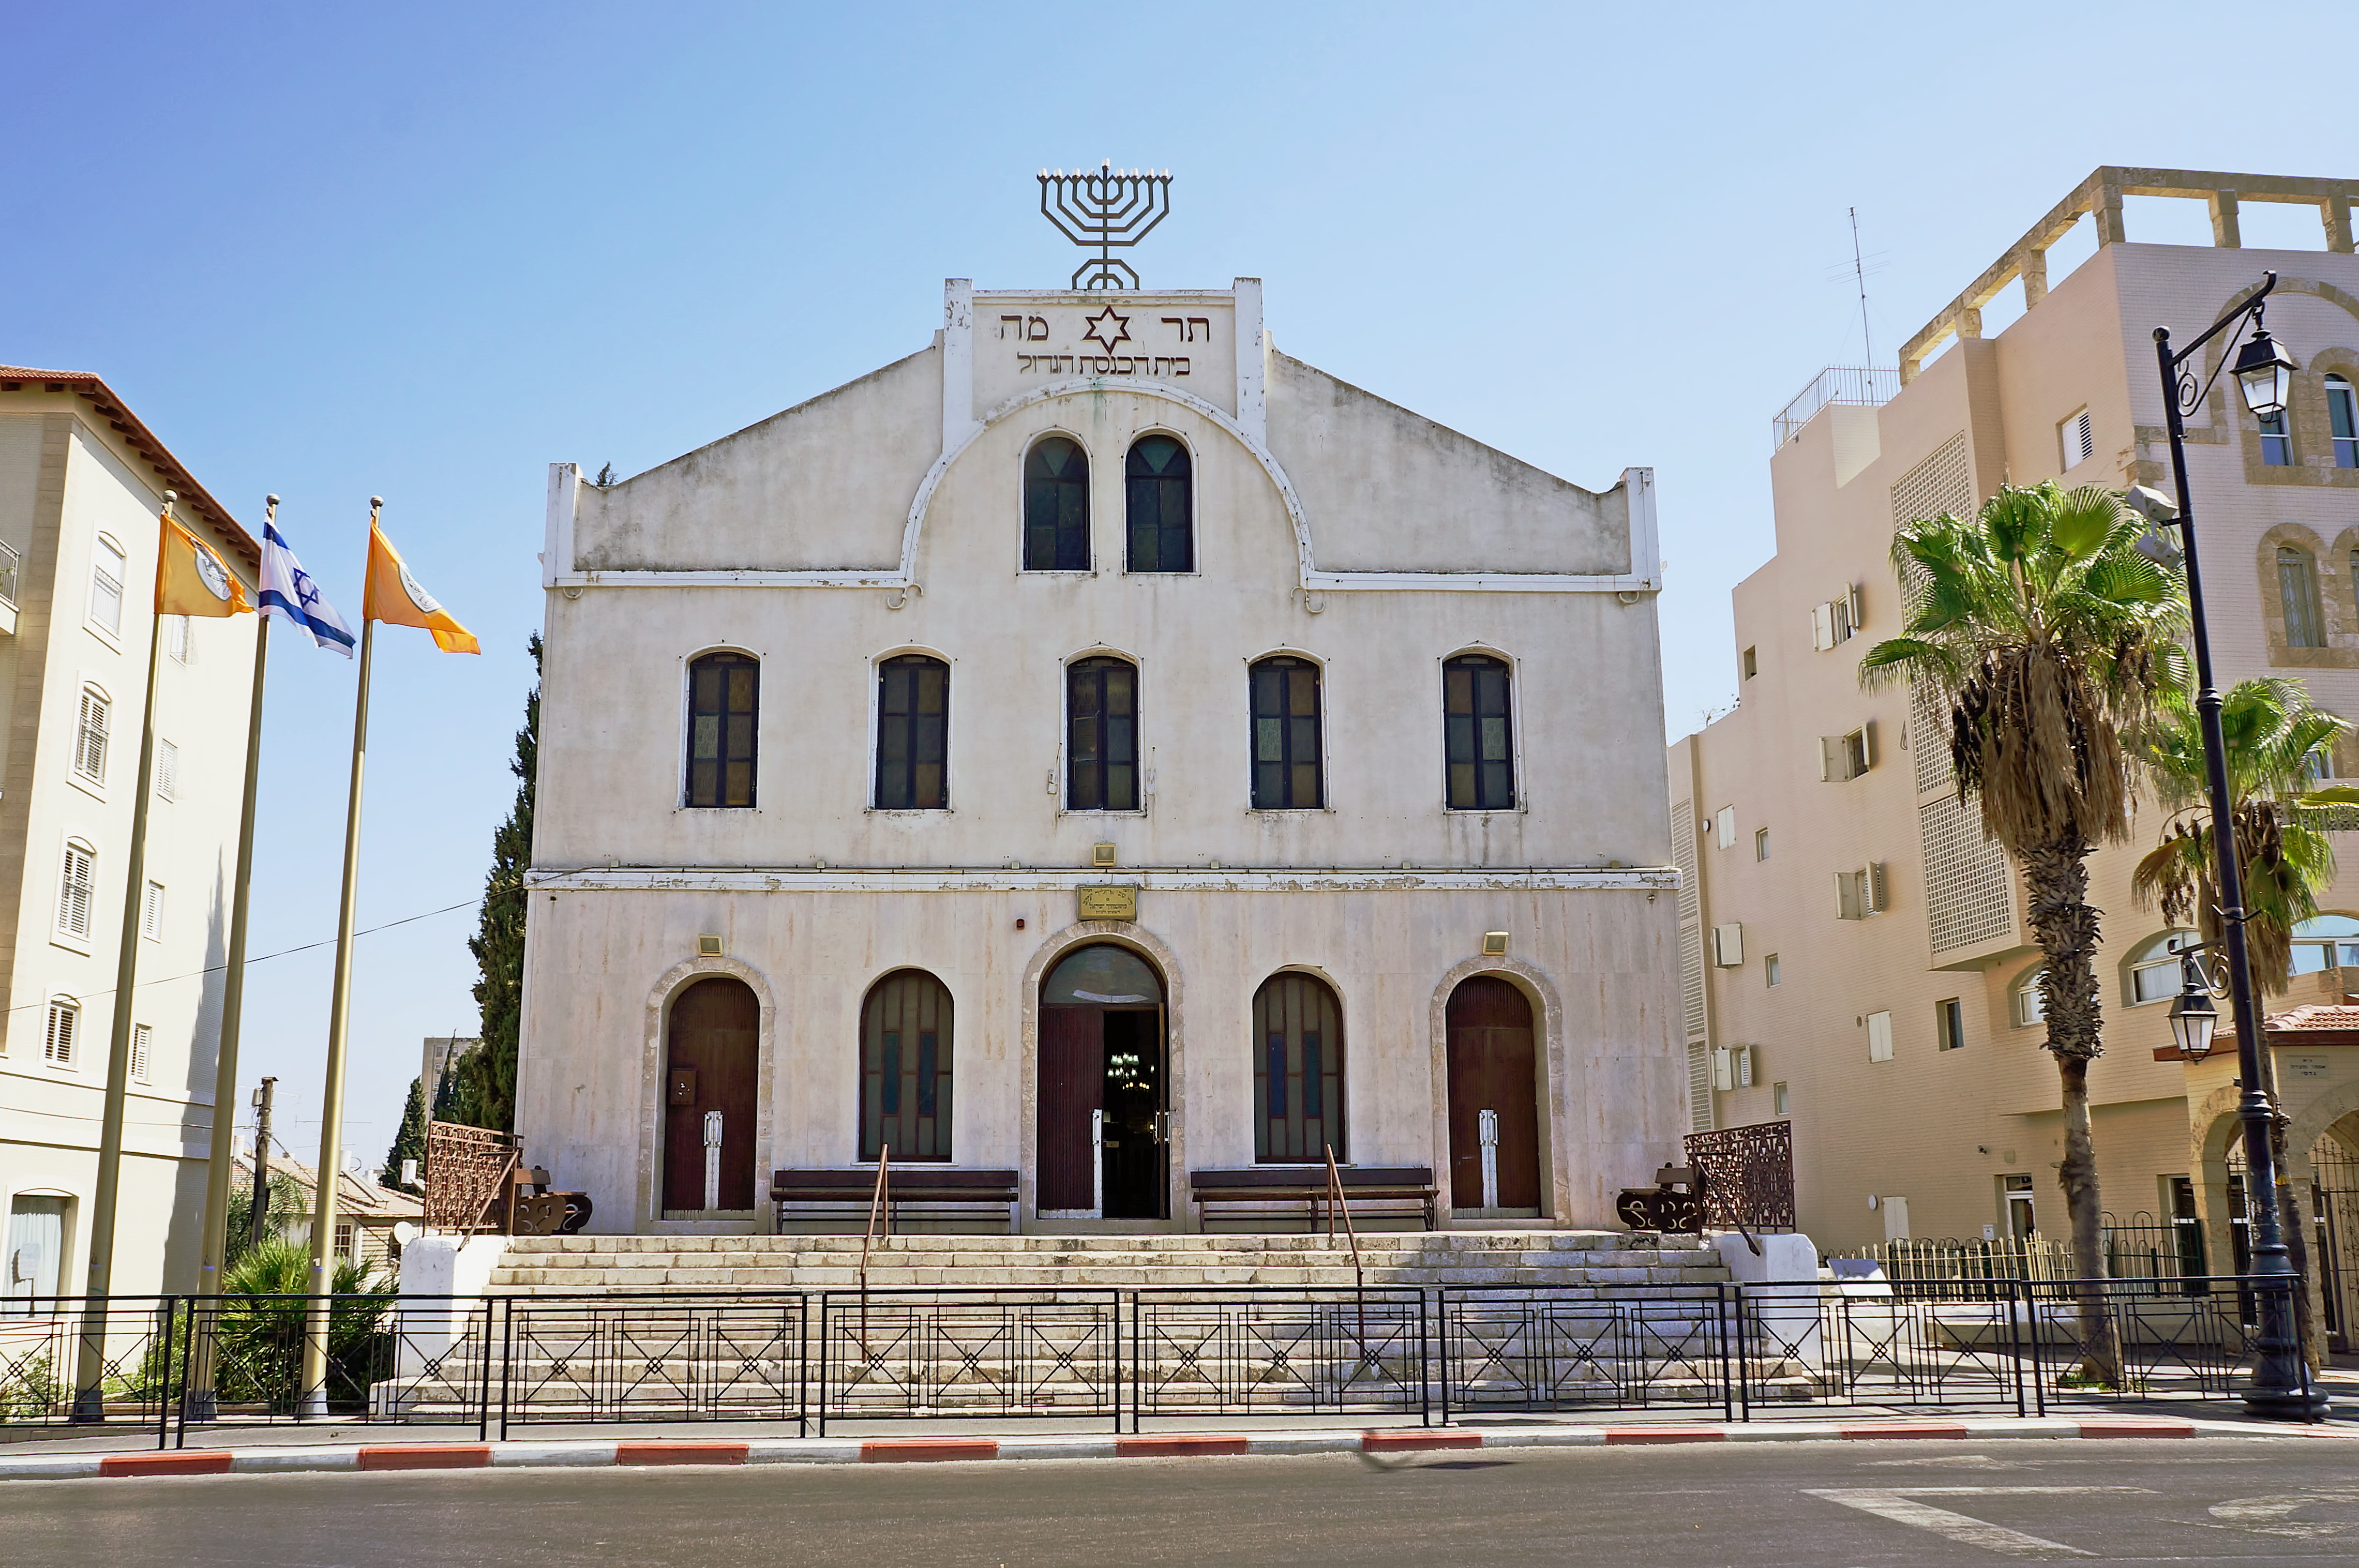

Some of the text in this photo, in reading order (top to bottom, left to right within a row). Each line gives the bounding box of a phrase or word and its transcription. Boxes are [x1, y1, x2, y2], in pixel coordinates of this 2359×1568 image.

[1000, 315, 1210, 342] תר מה
[1017, 351, 1190, 376] בית הכנסת הגדול
